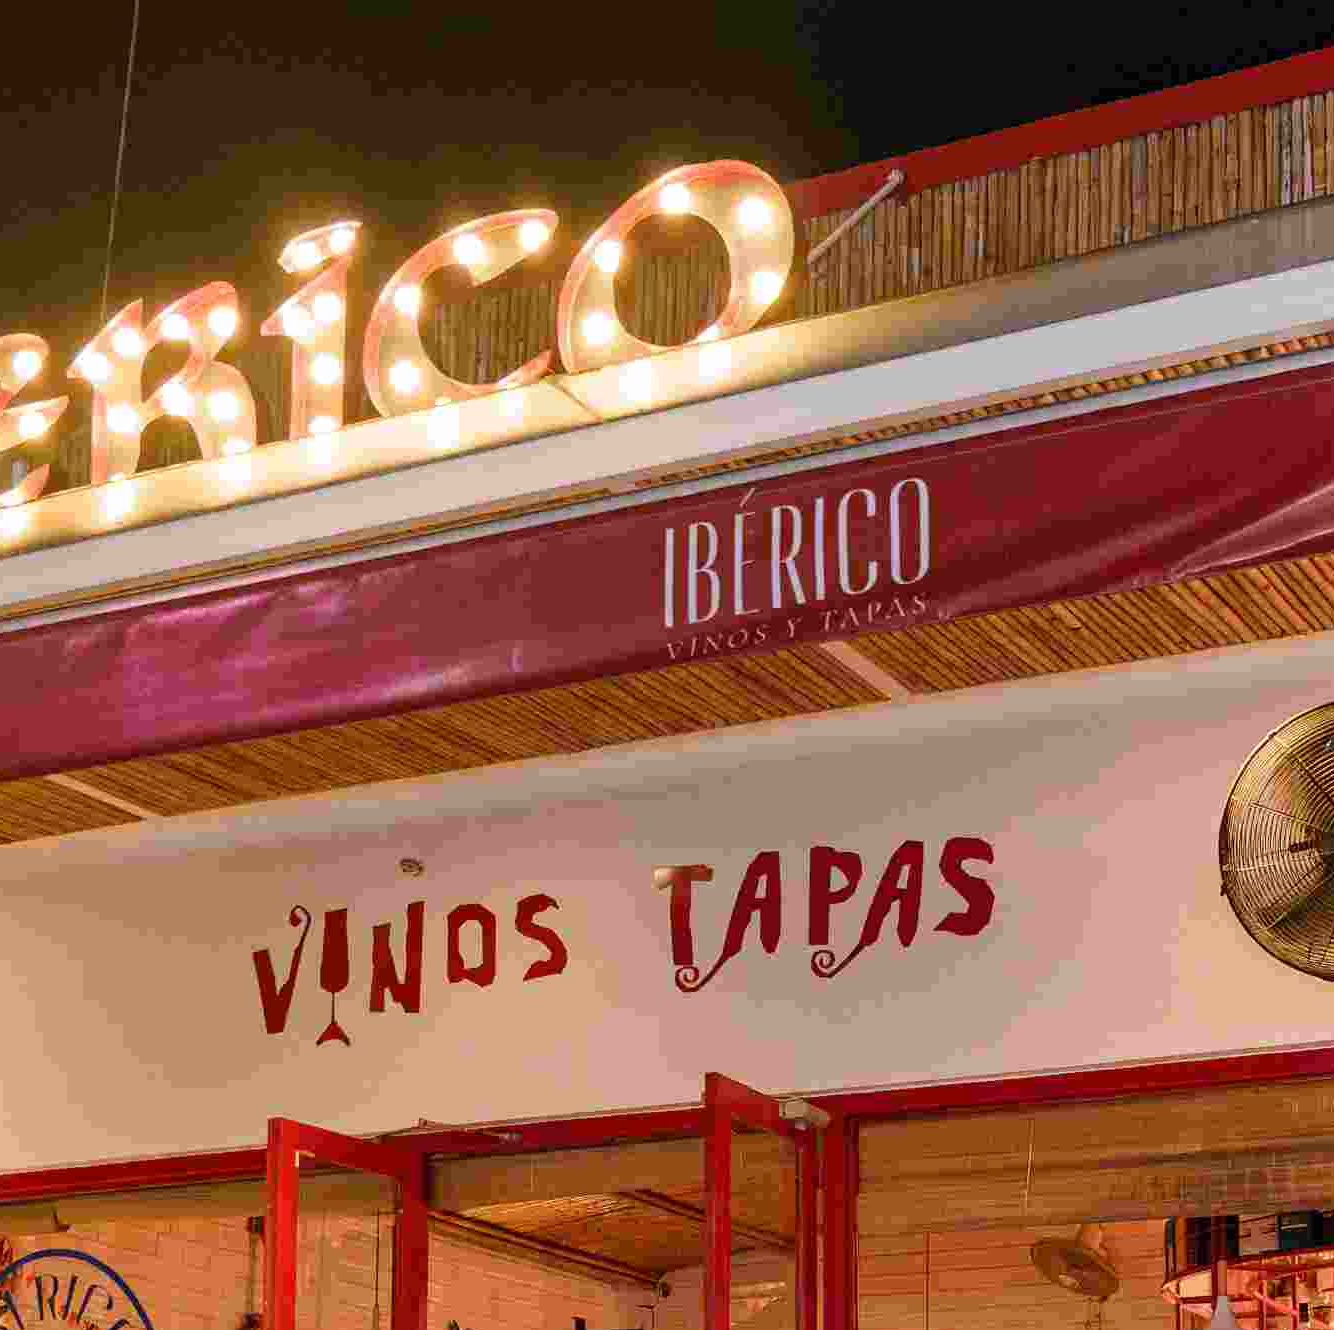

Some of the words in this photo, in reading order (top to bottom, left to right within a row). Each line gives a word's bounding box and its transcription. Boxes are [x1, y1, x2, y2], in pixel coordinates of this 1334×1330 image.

[663, 477, 931, 629] IBÉRICO
[665, 622, 769, 660] VINOS
[786, 616, 805, 638] Y
[820, 592, 930, 633] TAPAS
[251, 892, 570, 1048] VINOS
[652, 835, 997, 994] TAPAS
